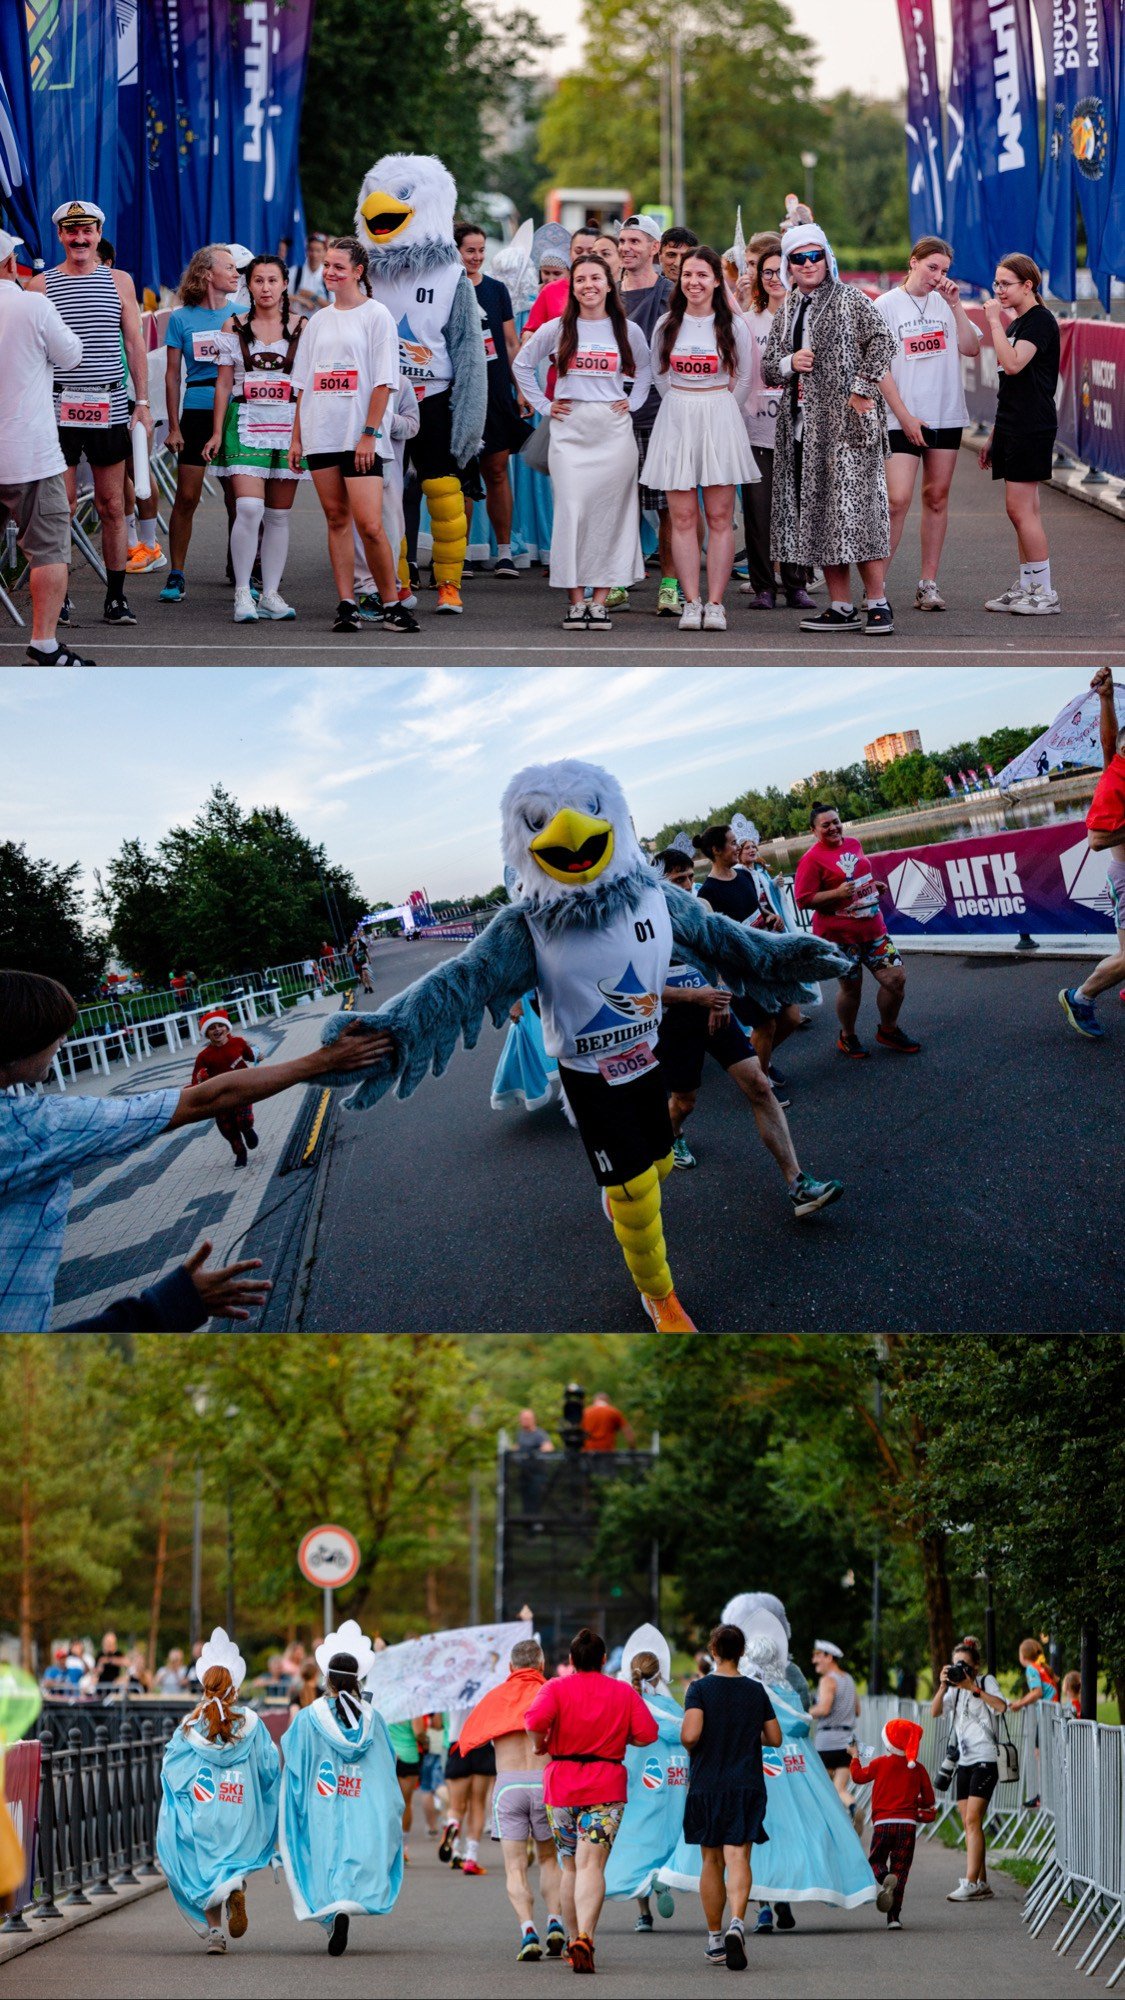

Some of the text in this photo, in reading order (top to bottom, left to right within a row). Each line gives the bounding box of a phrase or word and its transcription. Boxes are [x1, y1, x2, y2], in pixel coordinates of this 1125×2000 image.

[416, 287, 434, 304] 01
[910, 339, 940, 353] 5009
[575, 357, 609, 370] 5010
[675, 361, 711, 374] 5008
[320, 378, 350, 390] 5014
[250, 387, 284, 399] 5003
[67, 408, 102, 421] 5029
[945, 851, 1024, 898] НГК
[954, 896, 1027, 918] ресурс
[634, 918, 656, 943] 01
[575, 1018, 660, 1055] ВЕРШИНА
[607, 1053, 648, 1078] 5005
[224, 1769, 243, 1783] IT
[341, 1763, 361, 1777] IT
[219, 1782, 244, 1795] SKI
[338, 1775, 362, 1789] SKI
[218, 1794, 244, 1805] RACE
[338, 1787, 361, 1798] RACE
